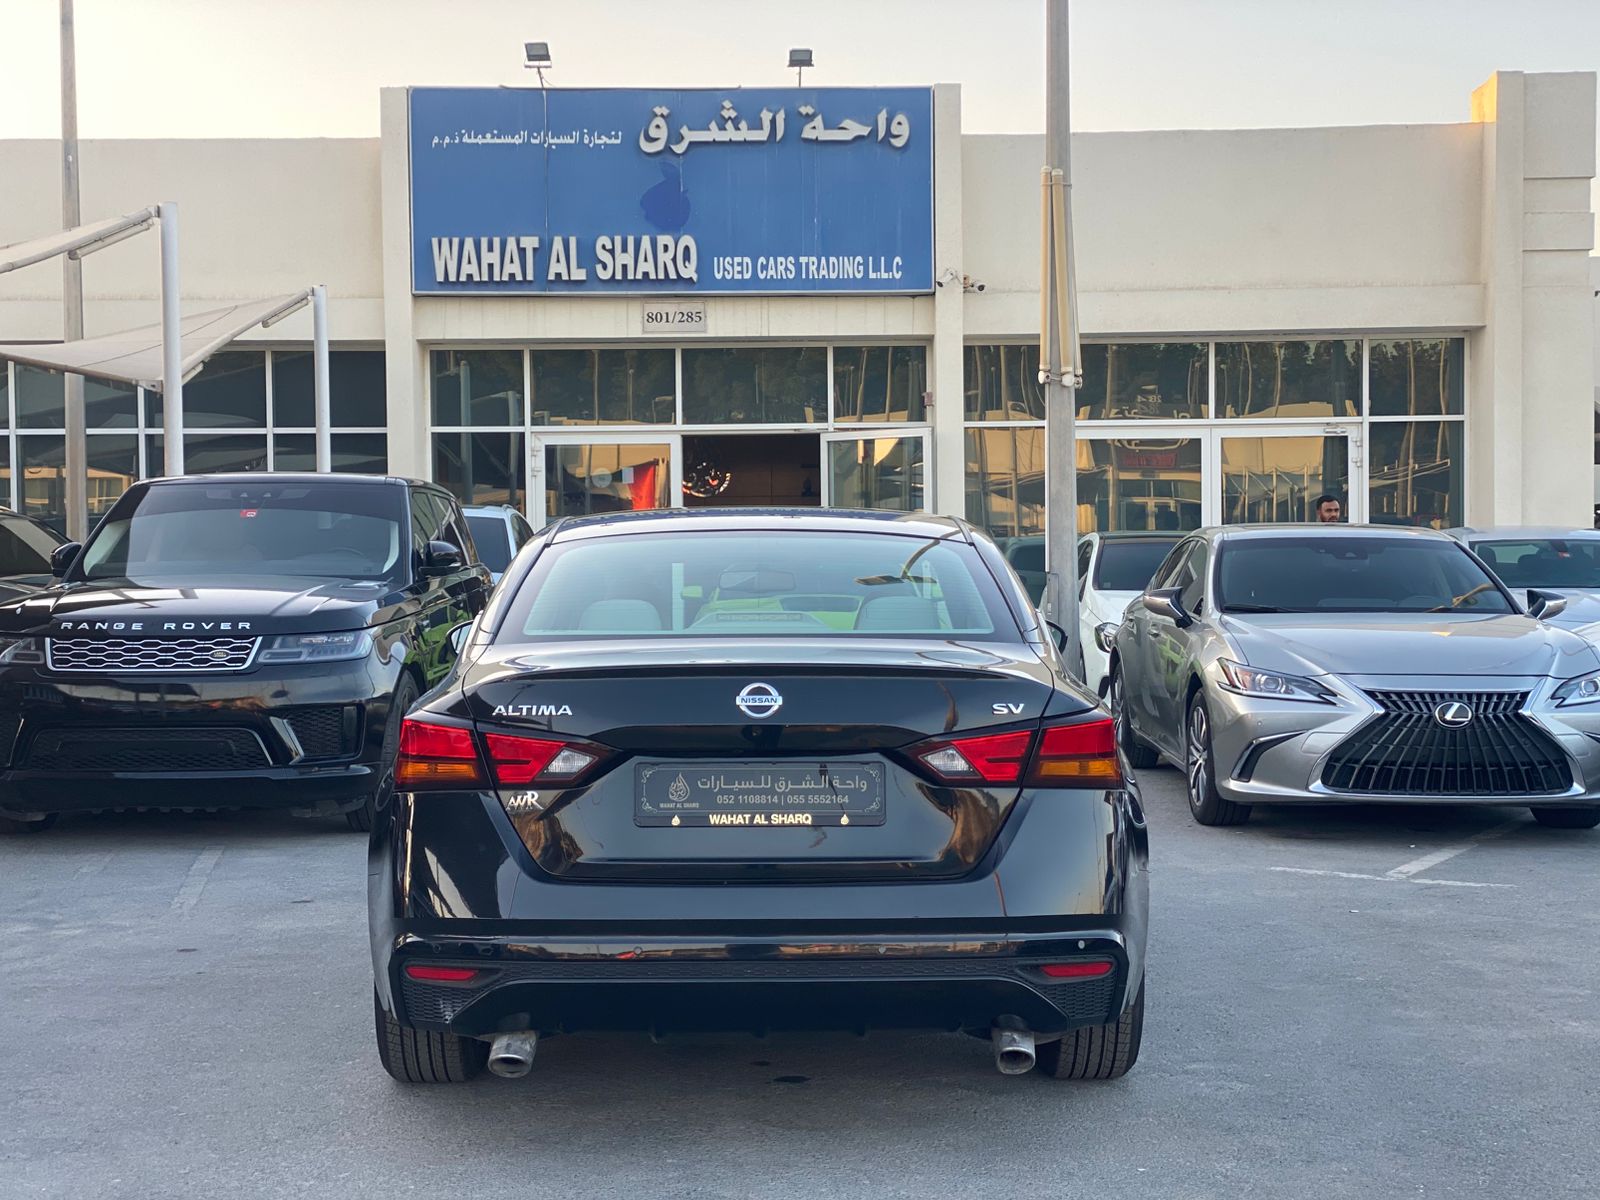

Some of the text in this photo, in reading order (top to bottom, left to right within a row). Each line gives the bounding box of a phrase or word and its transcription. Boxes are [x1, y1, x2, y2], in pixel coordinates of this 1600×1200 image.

[638, 99, 910, 154] واحة الشرق
[461, 128, 528, 145] المستعملة
[530, 129, 580, 149] السيارات
[583, 128, 622, 149] لتجارة
[431, 235, 698, 283] WAHAT AL SHARQ
[713, 256, 752, 280] USED
[757, 256, 796, 280] CARS
[799, 256, 864, 280] TRADING
[646, 310, 703, 324] 801/285
[60, 622, 251, 630] RANGE ROVER
[492, 704, 573, 716] ALTIMA
[992, 703, 1025, 715] SV
[697, 775, 771, 792] للسيارات
[774, 774, 829, 792] الشرق
[832, 775, 867, 792] واحة
[716, 795, 735, 804] 052
[738, 795, 779, 804] 1108814
[787, 795, 805, 804] 055
[807, 795, 849, 804] 5552164
[709, 814, 812, 825] WAHAT AL SHARQ
